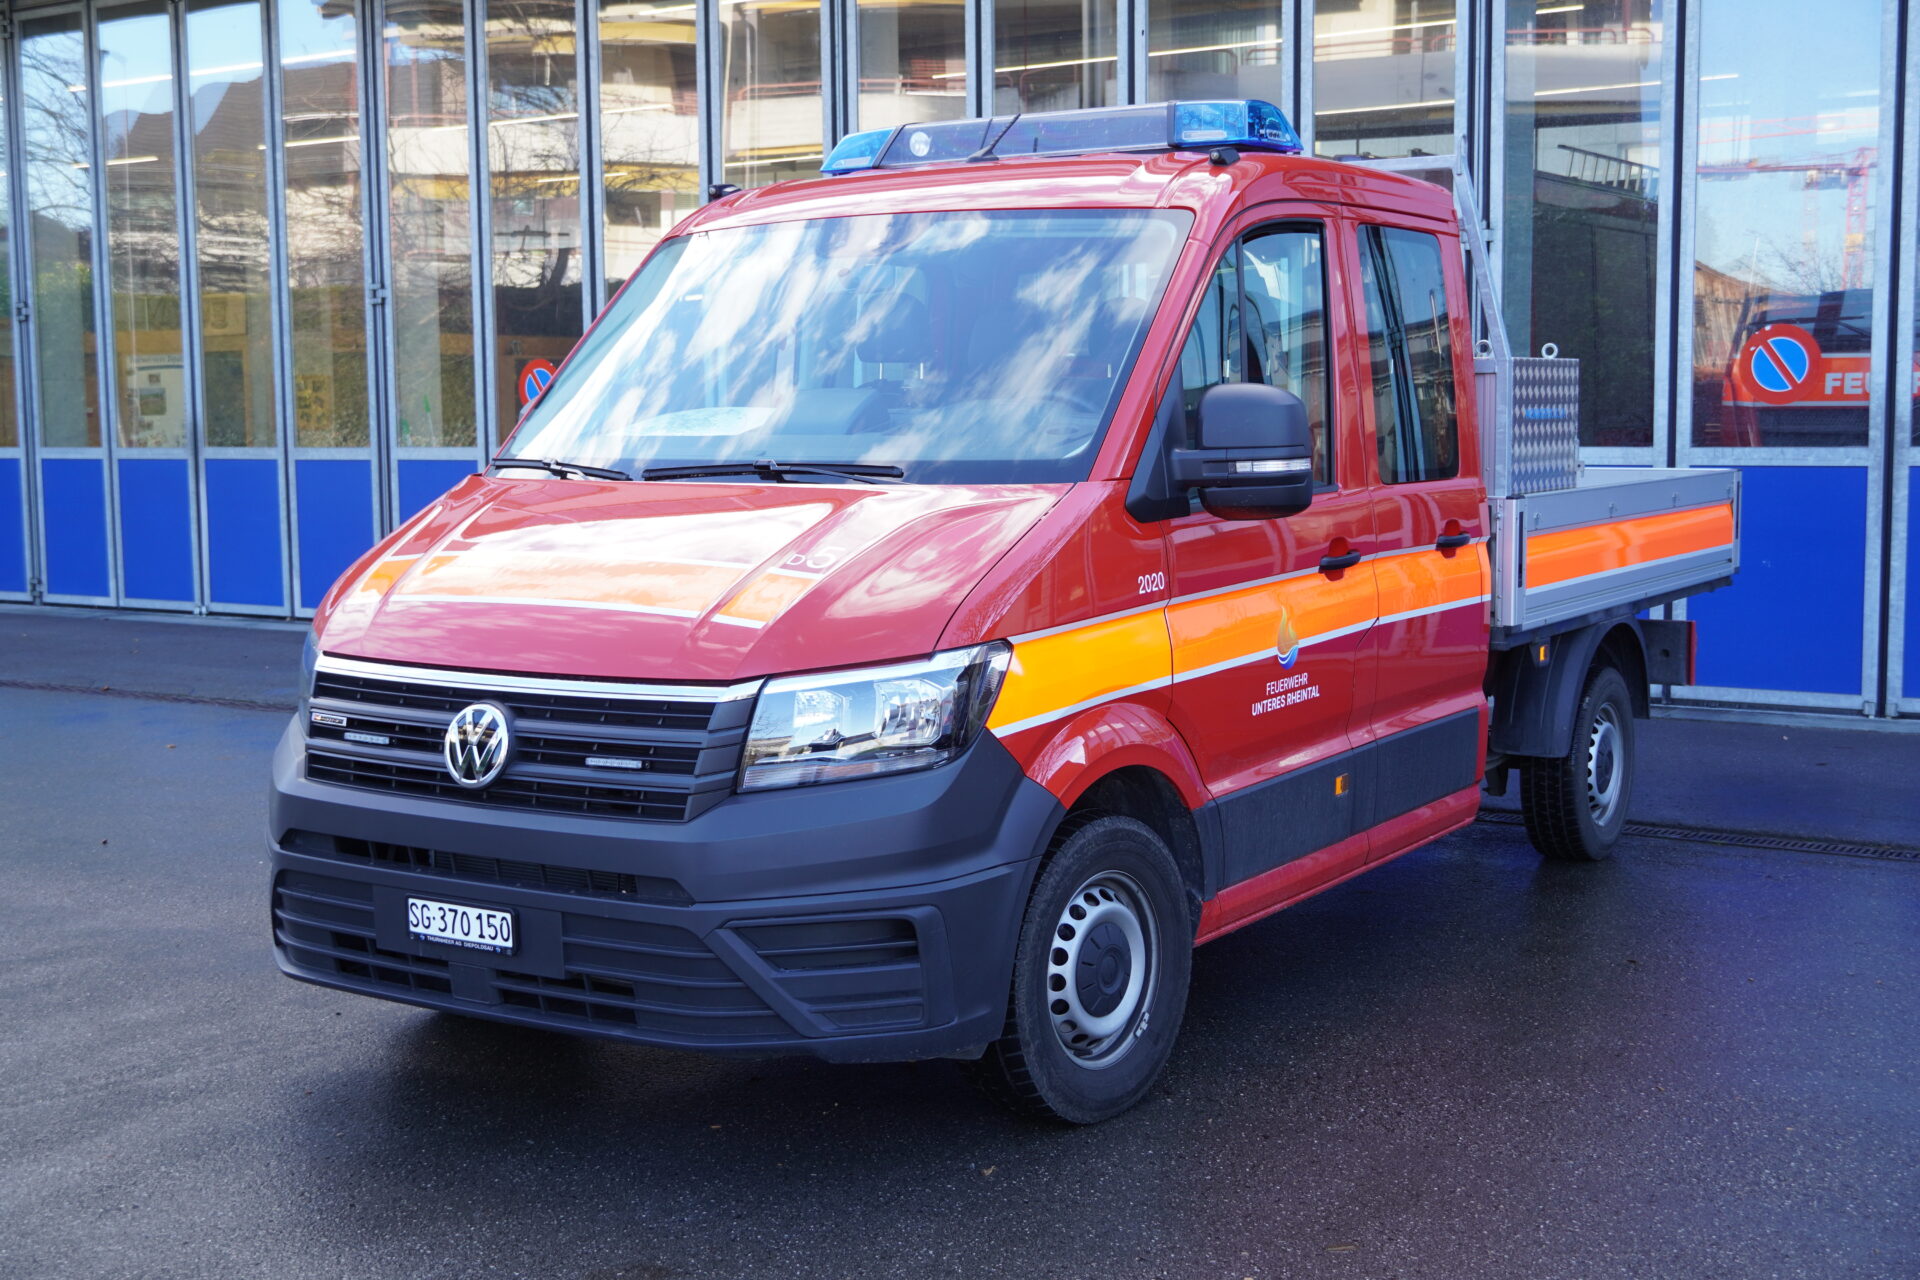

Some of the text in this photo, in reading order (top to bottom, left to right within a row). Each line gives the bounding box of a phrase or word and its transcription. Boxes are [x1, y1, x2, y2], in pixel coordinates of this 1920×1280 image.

[1137, 571, 1165, 595] 2020
[1266, 672, 1308, 696] FEUERWEHR
[1251, 685, 1320, 716] UNTERES RHEINTAL
[475, 912, 511, 942] 150
